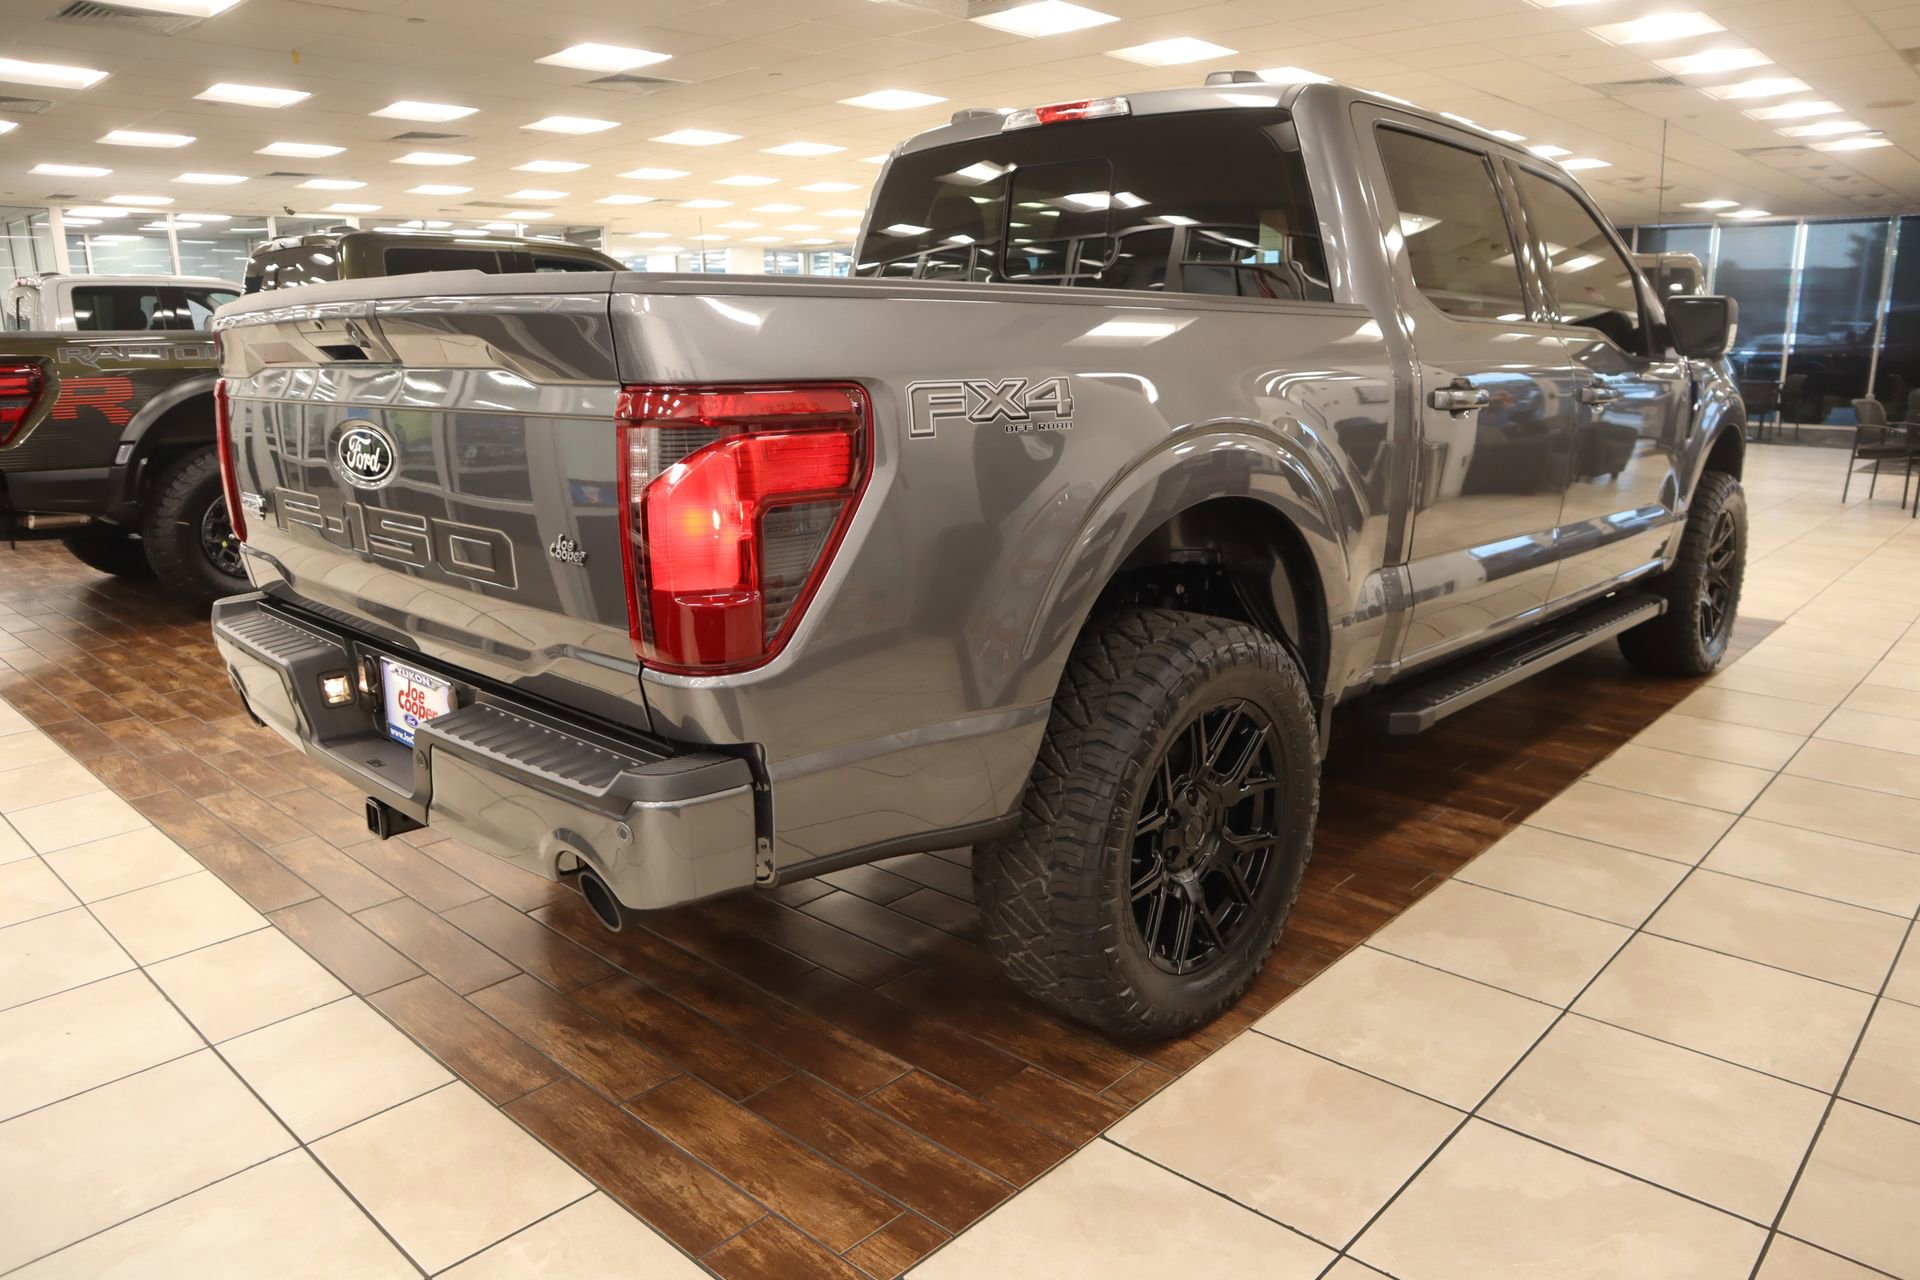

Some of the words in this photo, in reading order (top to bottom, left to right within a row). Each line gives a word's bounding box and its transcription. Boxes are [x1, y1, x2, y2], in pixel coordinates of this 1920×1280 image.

[57, 344, 219, 370] RAPTO
[905, 376, 1074, 440] FX4
[1004, 423, 1033, 434] OFF
[1037, 421, 1074, 432] ROAD
[346, 434, 381, 473] Ford
[273, 486, 518, 591] F-150
[555, 533, 575, 552] Joe
[549, 541, 587, 563] Cooper
[398, 689, 438, 721] Cooper
[405, 679, 426, 705] Joe
